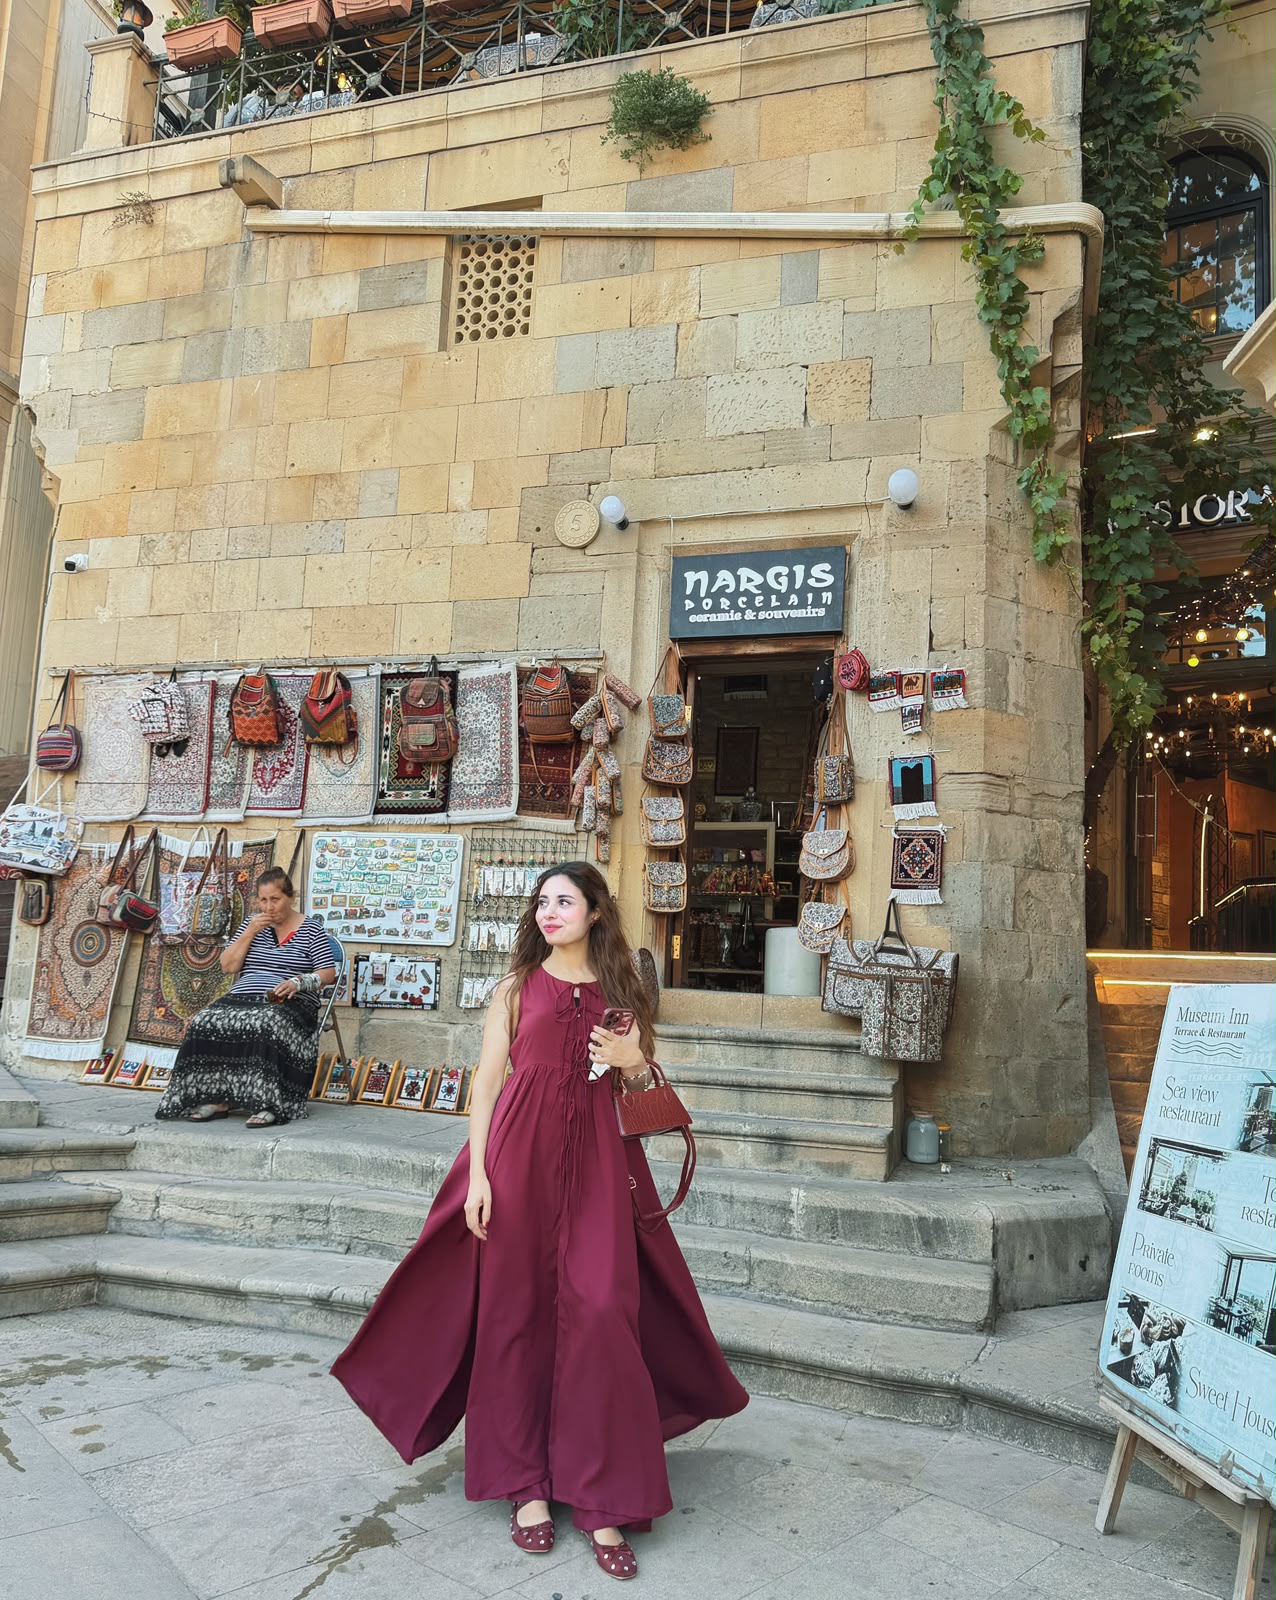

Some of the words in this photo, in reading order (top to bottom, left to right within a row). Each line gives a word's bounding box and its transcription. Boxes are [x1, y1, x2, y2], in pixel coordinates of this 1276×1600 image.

[570, 514, 583, 532] 5
[683, 562, 835, 598] NARGIS
[684, 591, 833, 611] PORCELAIN
[689, 609, 742, 623] ceramic
[744, 608, 757, 621] &
[758, 605, 826, 620] souvenirs
[1176, 1006, 1225, 1024] Museum
[1228, 1007, 1249, 1025] Inn
[1174, 1026, 1198, 1037] Terrace
[1199, 1027, 1206, 1037] &
[1207, 1028, 1247, 1039] Restaurant
[1162, 1075, 1187, 1101] Sea
[1191, 1085, 1219, 1104] view
[1131, 1231, 1175, 1268] Private
[1185, 1366, 1230, 1412] Sweet
